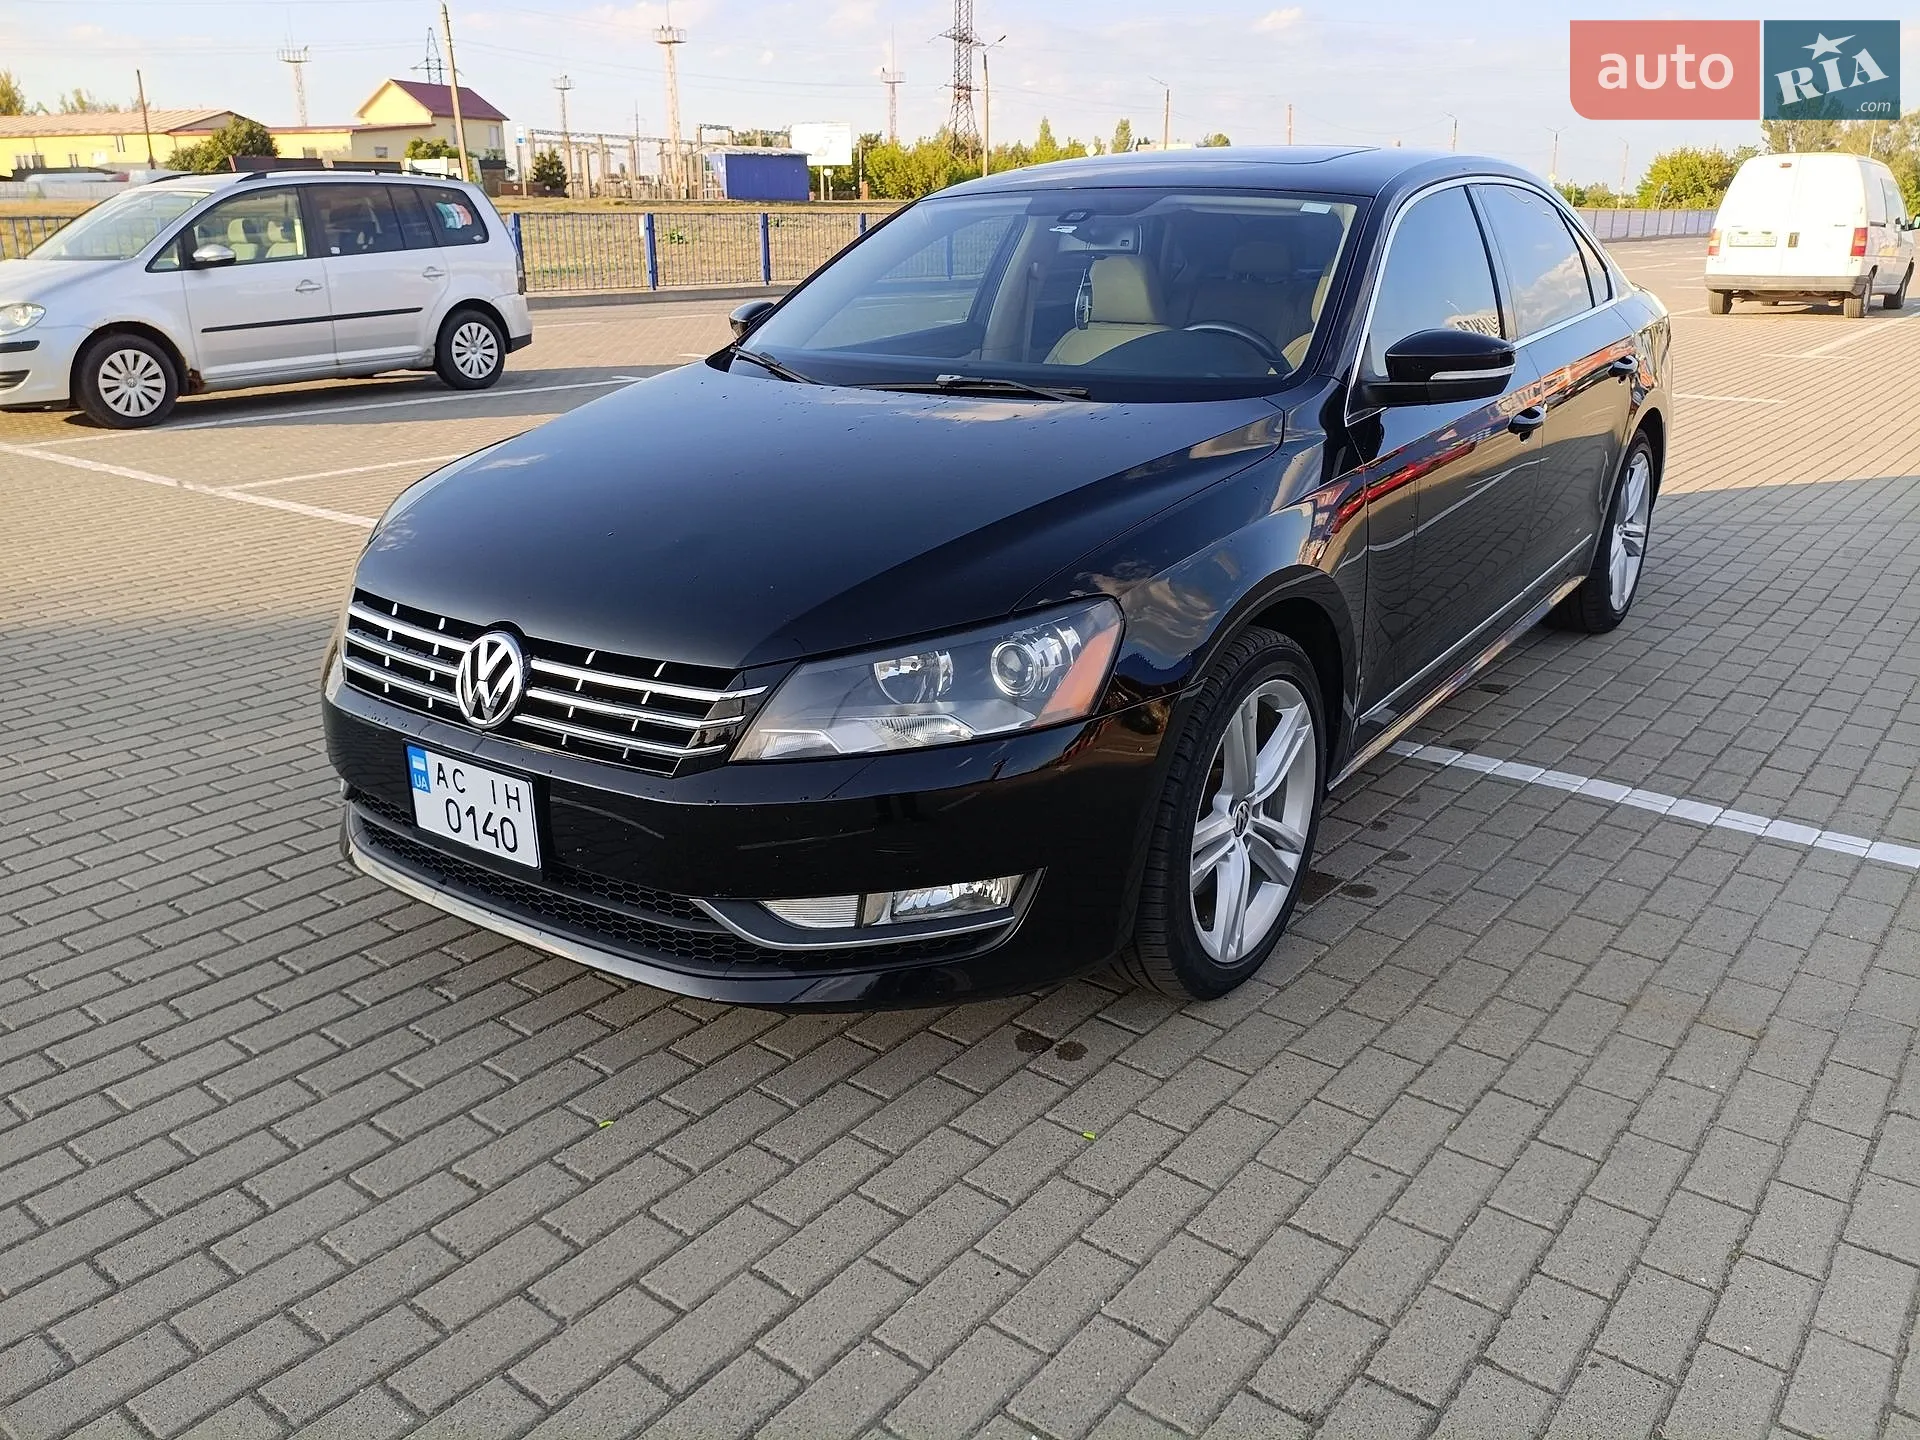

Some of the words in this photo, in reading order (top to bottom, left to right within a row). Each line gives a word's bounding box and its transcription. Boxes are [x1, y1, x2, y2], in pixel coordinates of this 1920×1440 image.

[413, 773, 429, 791] UA
[436, 762, 466, 794] AC
[445, 797, 518, 853] 0140
